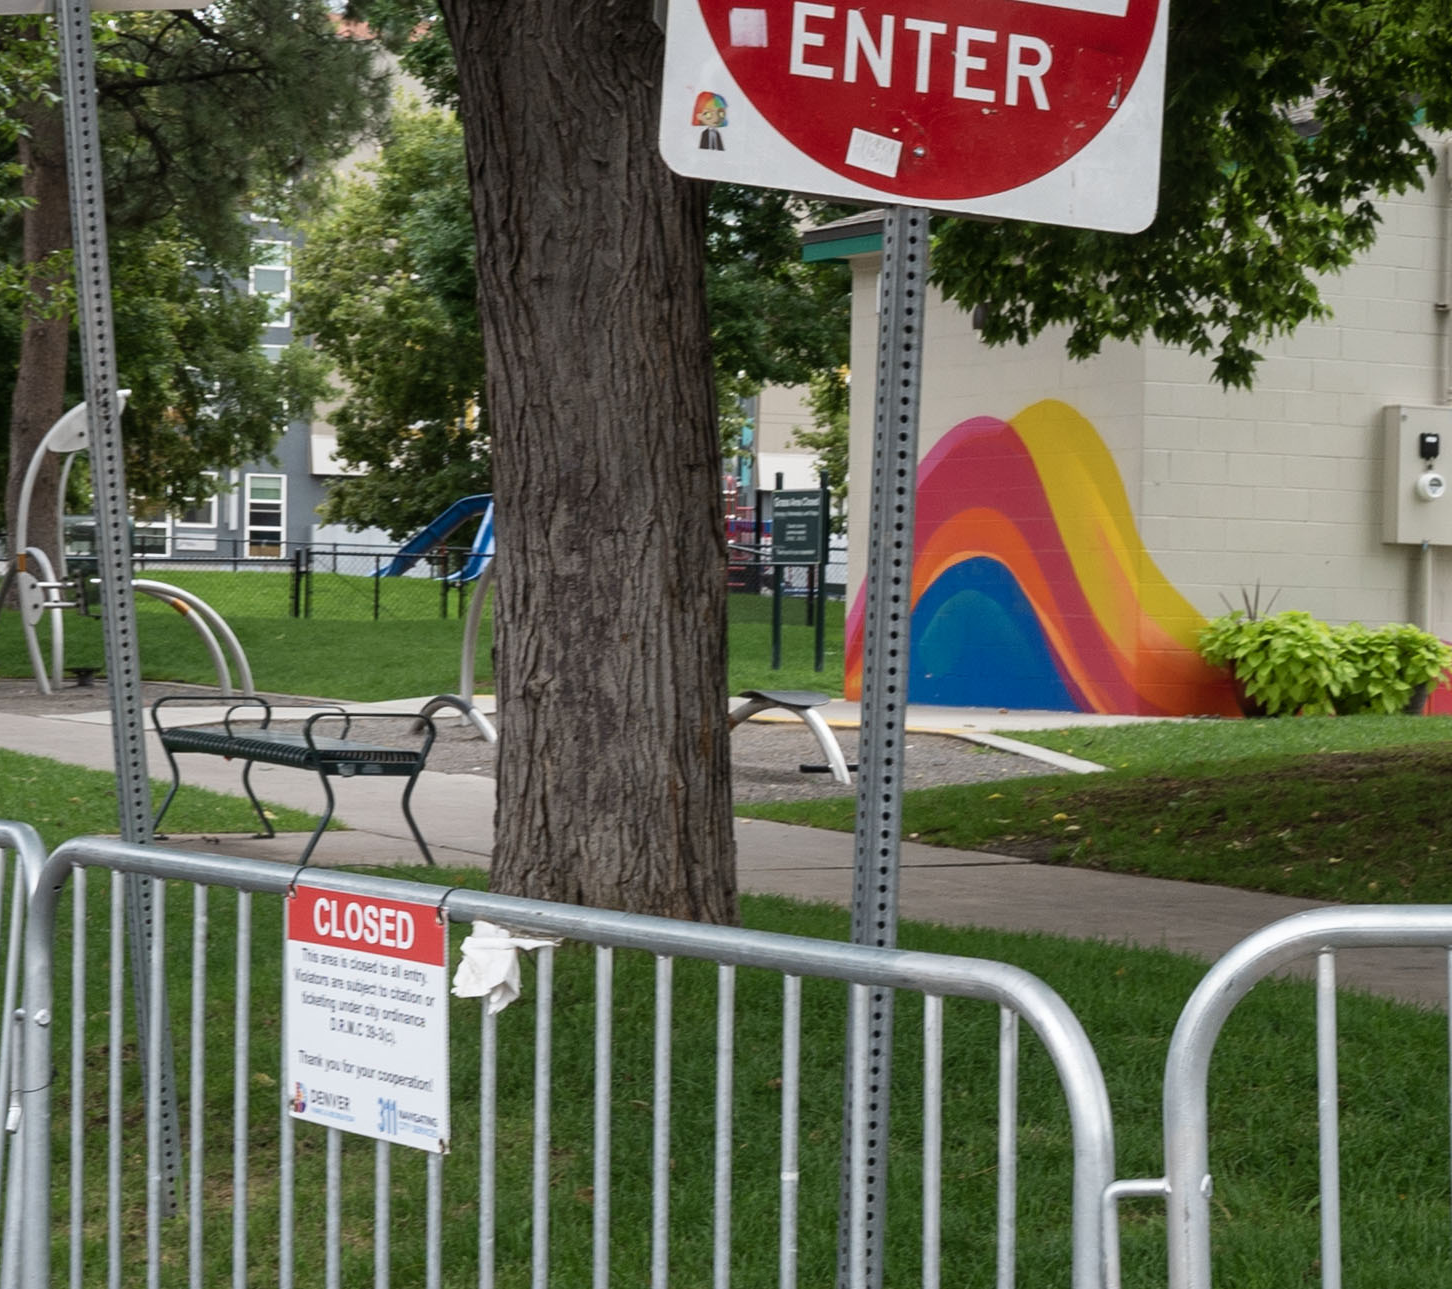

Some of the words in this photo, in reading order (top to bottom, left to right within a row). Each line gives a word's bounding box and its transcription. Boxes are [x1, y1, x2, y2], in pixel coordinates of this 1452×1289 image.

[789, 0, 1053, 111] ENTER
[313, 897, 415, 950] CLOSED
[301, 947, 318, 963] This
[321, 954, 338, 967] area
[350, 956, 378, 974] closed
[380, 962, 388, 976] to
[391, 964, 401, 978] all
[294, 968, 328, 987] Violators
[332, 977, 344, 989] are
[347, 979, 377, 997] subject
[379, 985, 387, 998] to
[390, 987, 422, 1004] citation
[426, 996, 436, 1007] or
[301, 991, 336, 1013] ticketing
[339, 999, 362, 1014] under
[365, 1002, 379, 1022] city
[382, 1008, 426, 1028] ordinance
[298, 1049, 323, 1067] Thank
[325, 1058, 340, 1072] you
[342, 1059, 355, 1073] for
[356, 1066, 376, 1080] your
[310, 1089, 351, 1111] DENVER
